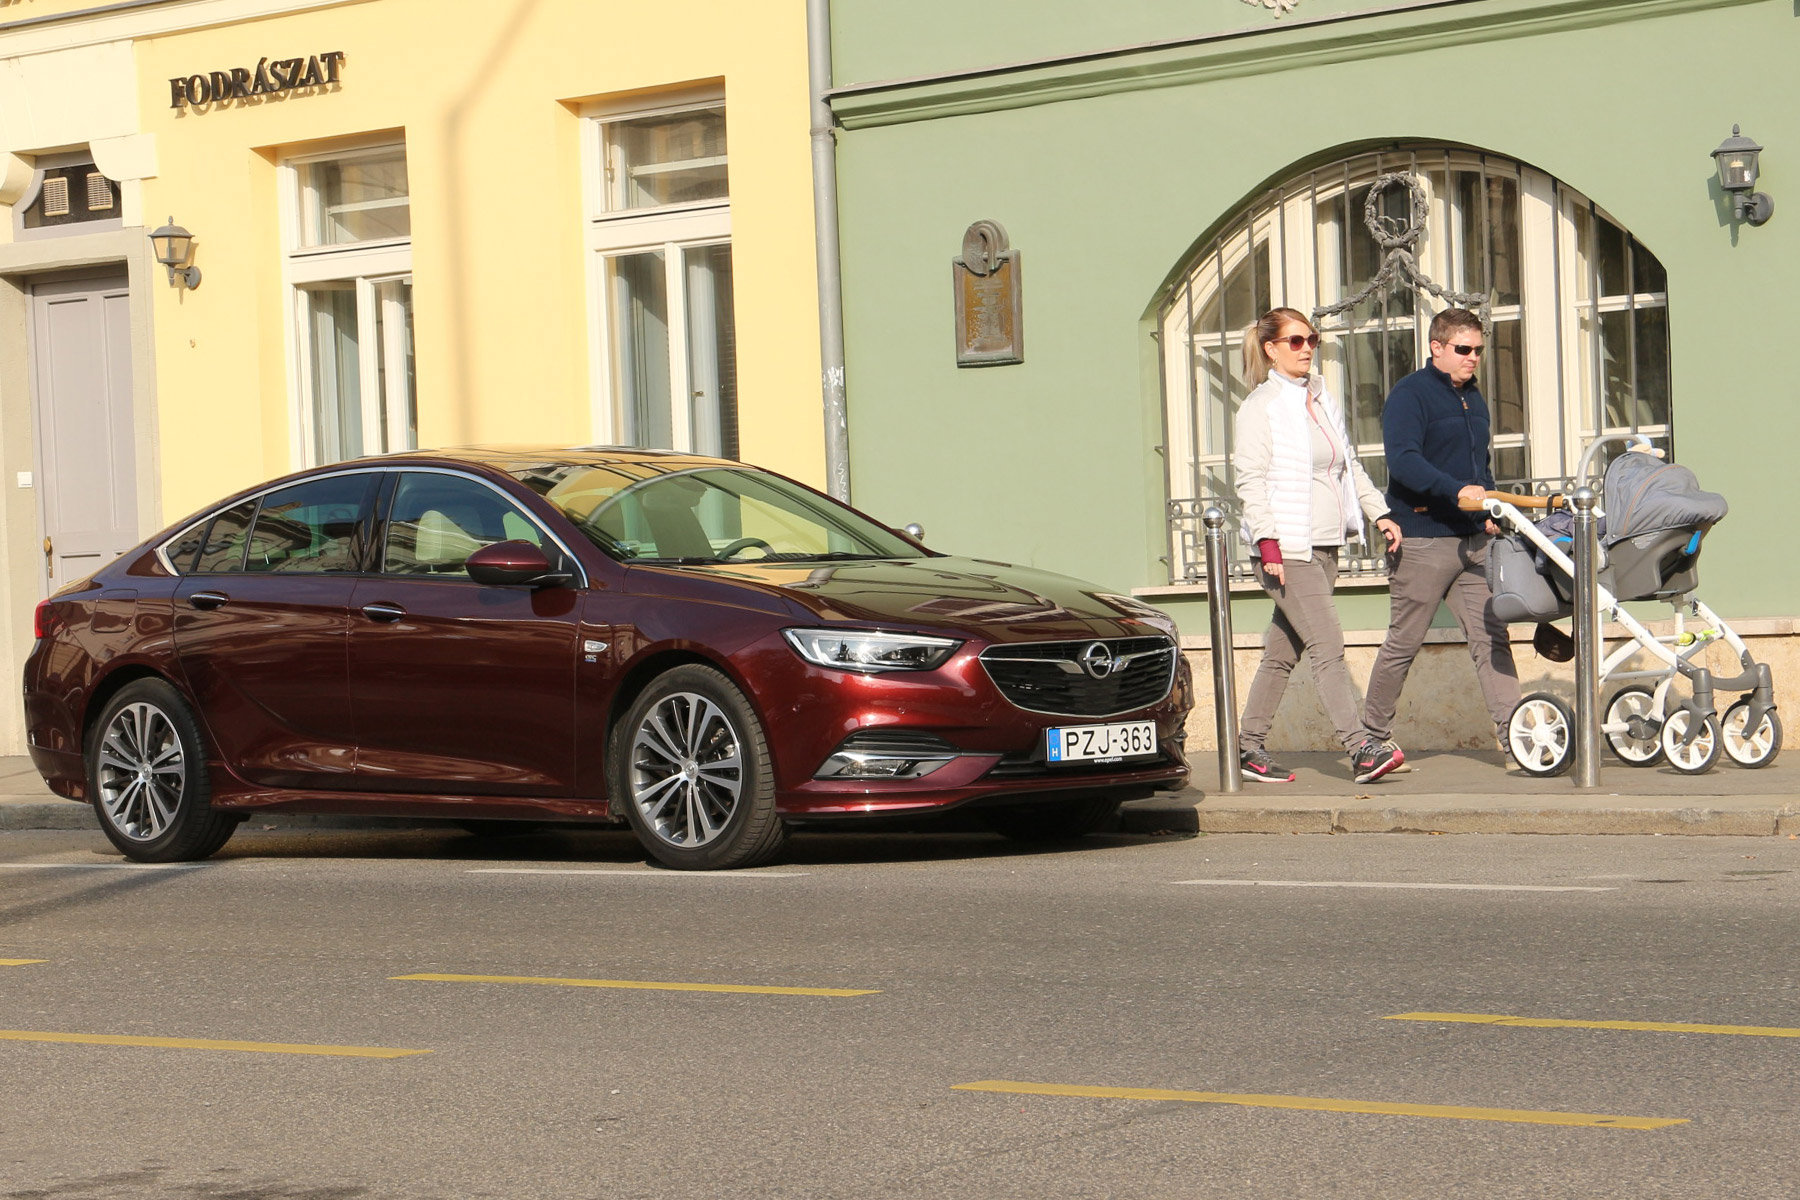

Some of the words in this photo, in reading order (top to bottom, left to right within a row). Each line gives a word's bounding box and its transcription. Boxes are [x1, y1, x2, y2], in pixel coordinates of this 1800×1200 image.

[168, 51, 344, 109] FODRÁSZAT
[1051, 747, 1059, 757] H
[1066, 726, 1152, 757] PZJ-363
